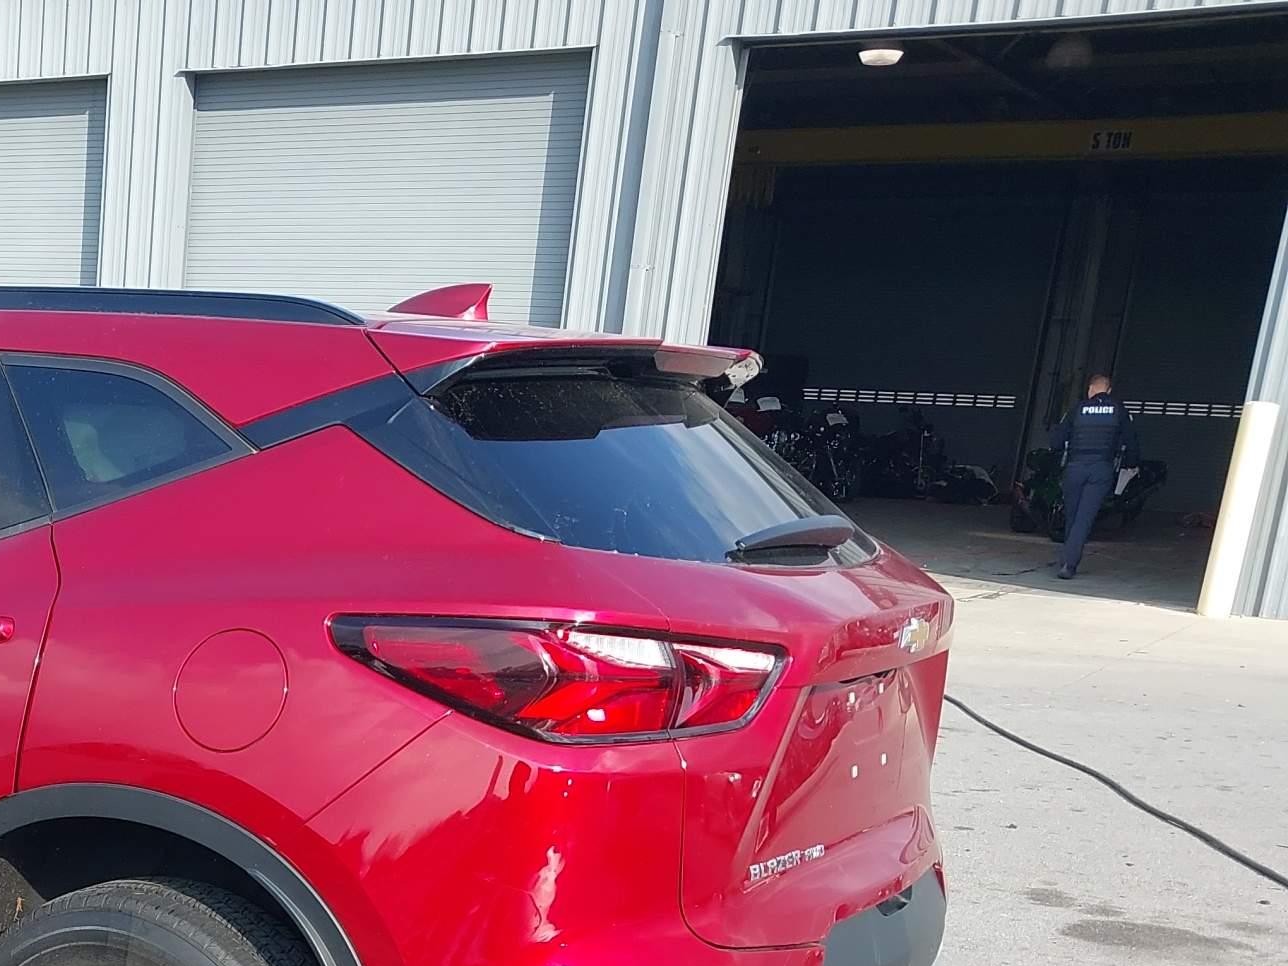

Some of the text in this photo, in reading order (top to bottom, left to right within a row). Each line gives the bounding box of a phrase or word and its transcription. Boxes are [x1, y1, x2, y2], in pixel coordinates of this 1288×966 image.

[1105, 131, 1132, 150] TON
[1082, 406, 1115, 415] POLICE
[749, 850, 801, 881] BLAZER
